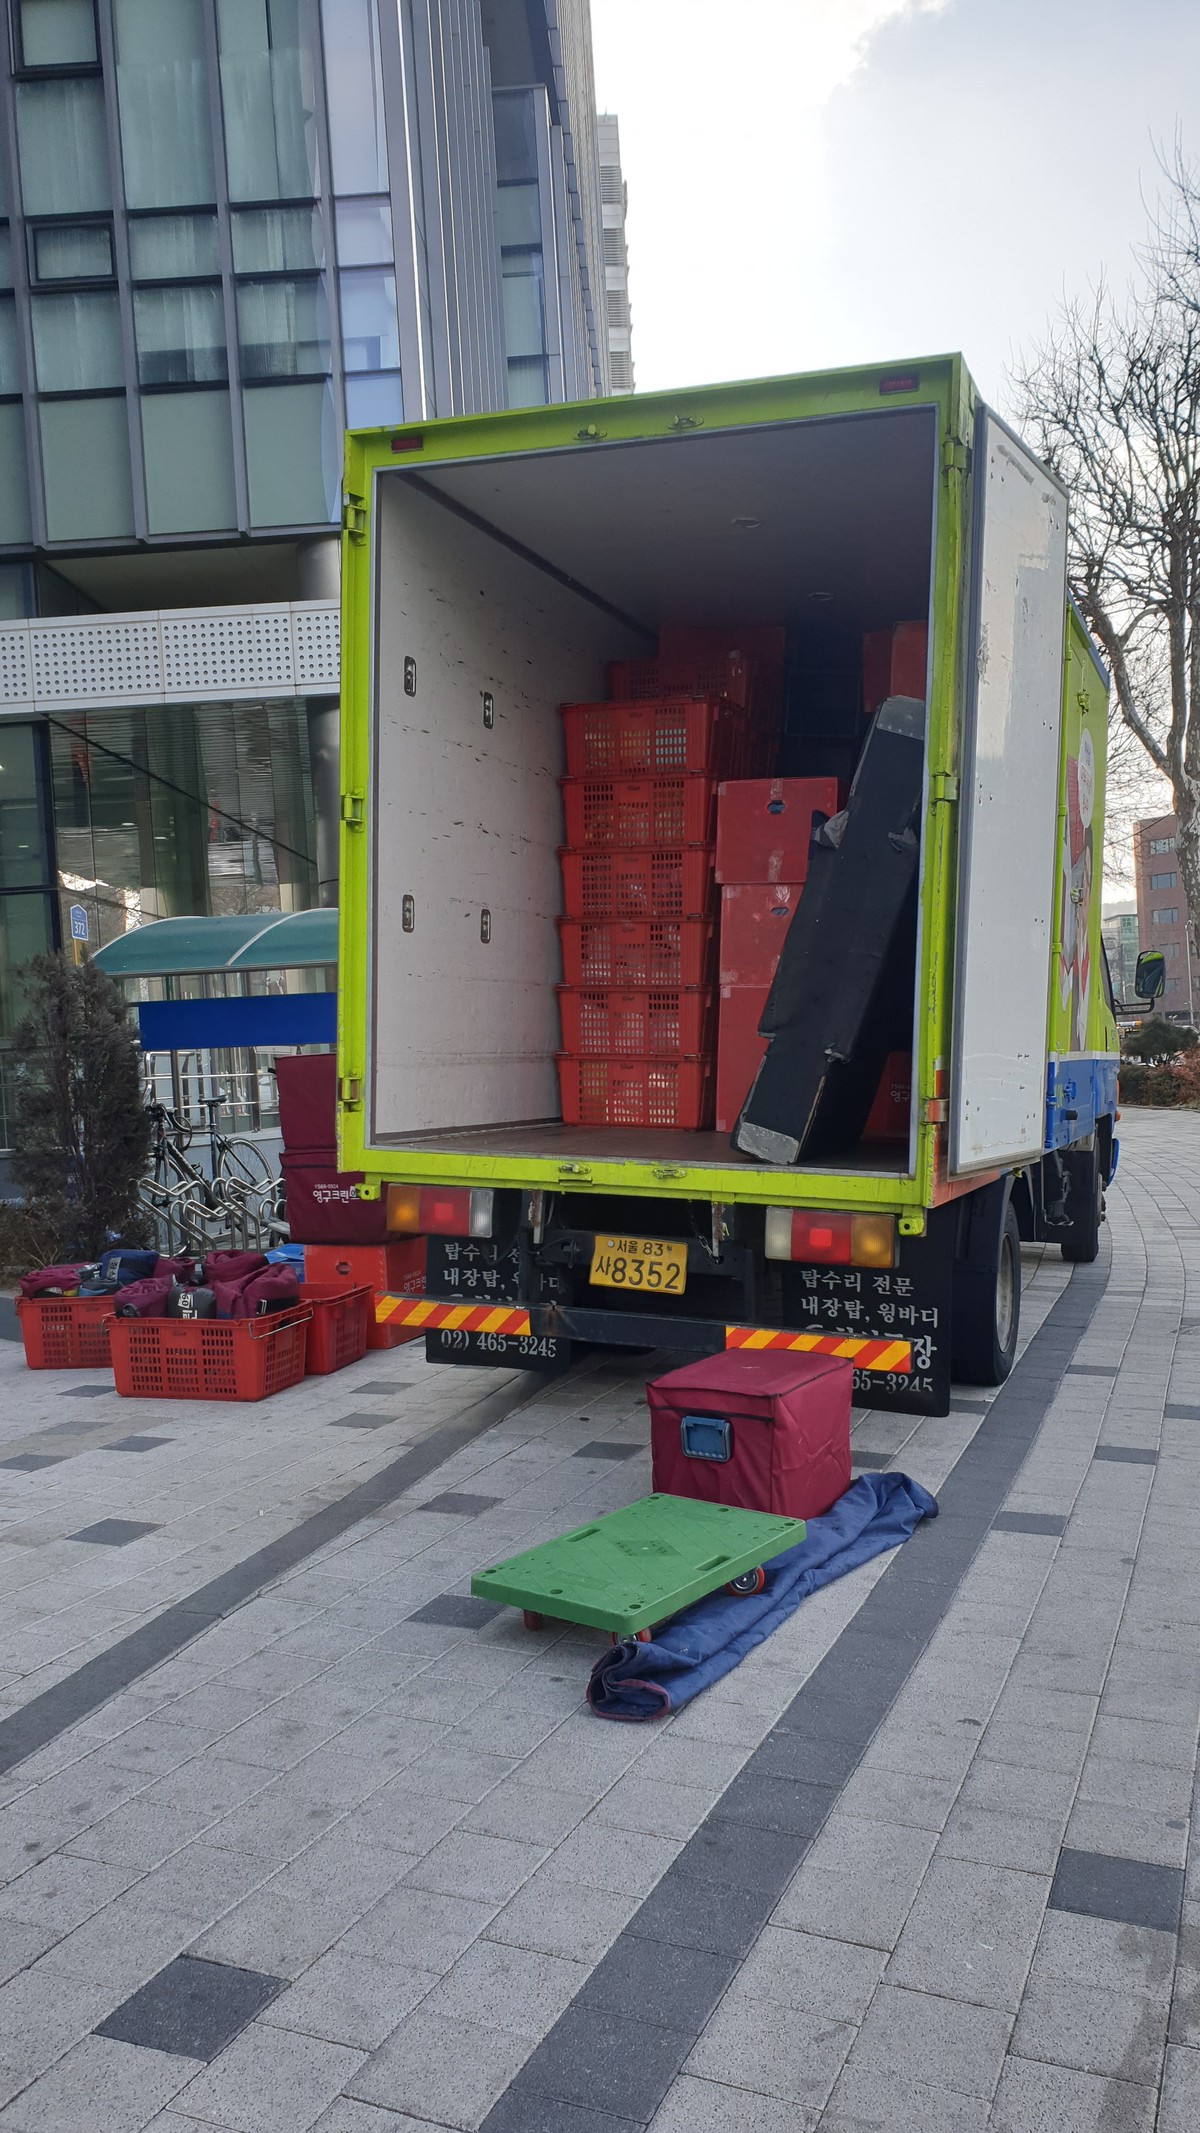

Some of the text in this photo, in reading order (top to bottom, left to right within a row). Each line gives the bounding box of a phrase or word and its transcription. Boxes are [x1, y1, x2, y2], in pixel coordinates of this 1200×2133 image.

[74, 921, 85, 935] 372
[312, 1190, 349, 1203] 영구크린
[617, 1240, 663, 1256] 서울 83
[443, 1267, 506, 1290] 내장탑,
[801, 1269, 914, 1297] 탑수리 전문
[801, 1295, 938, 1328] 내장탑, 윙바디
[441, 1329, 557, 1358] 02) 465-3245
[852, 1369, 934, 1394] 65-3245
